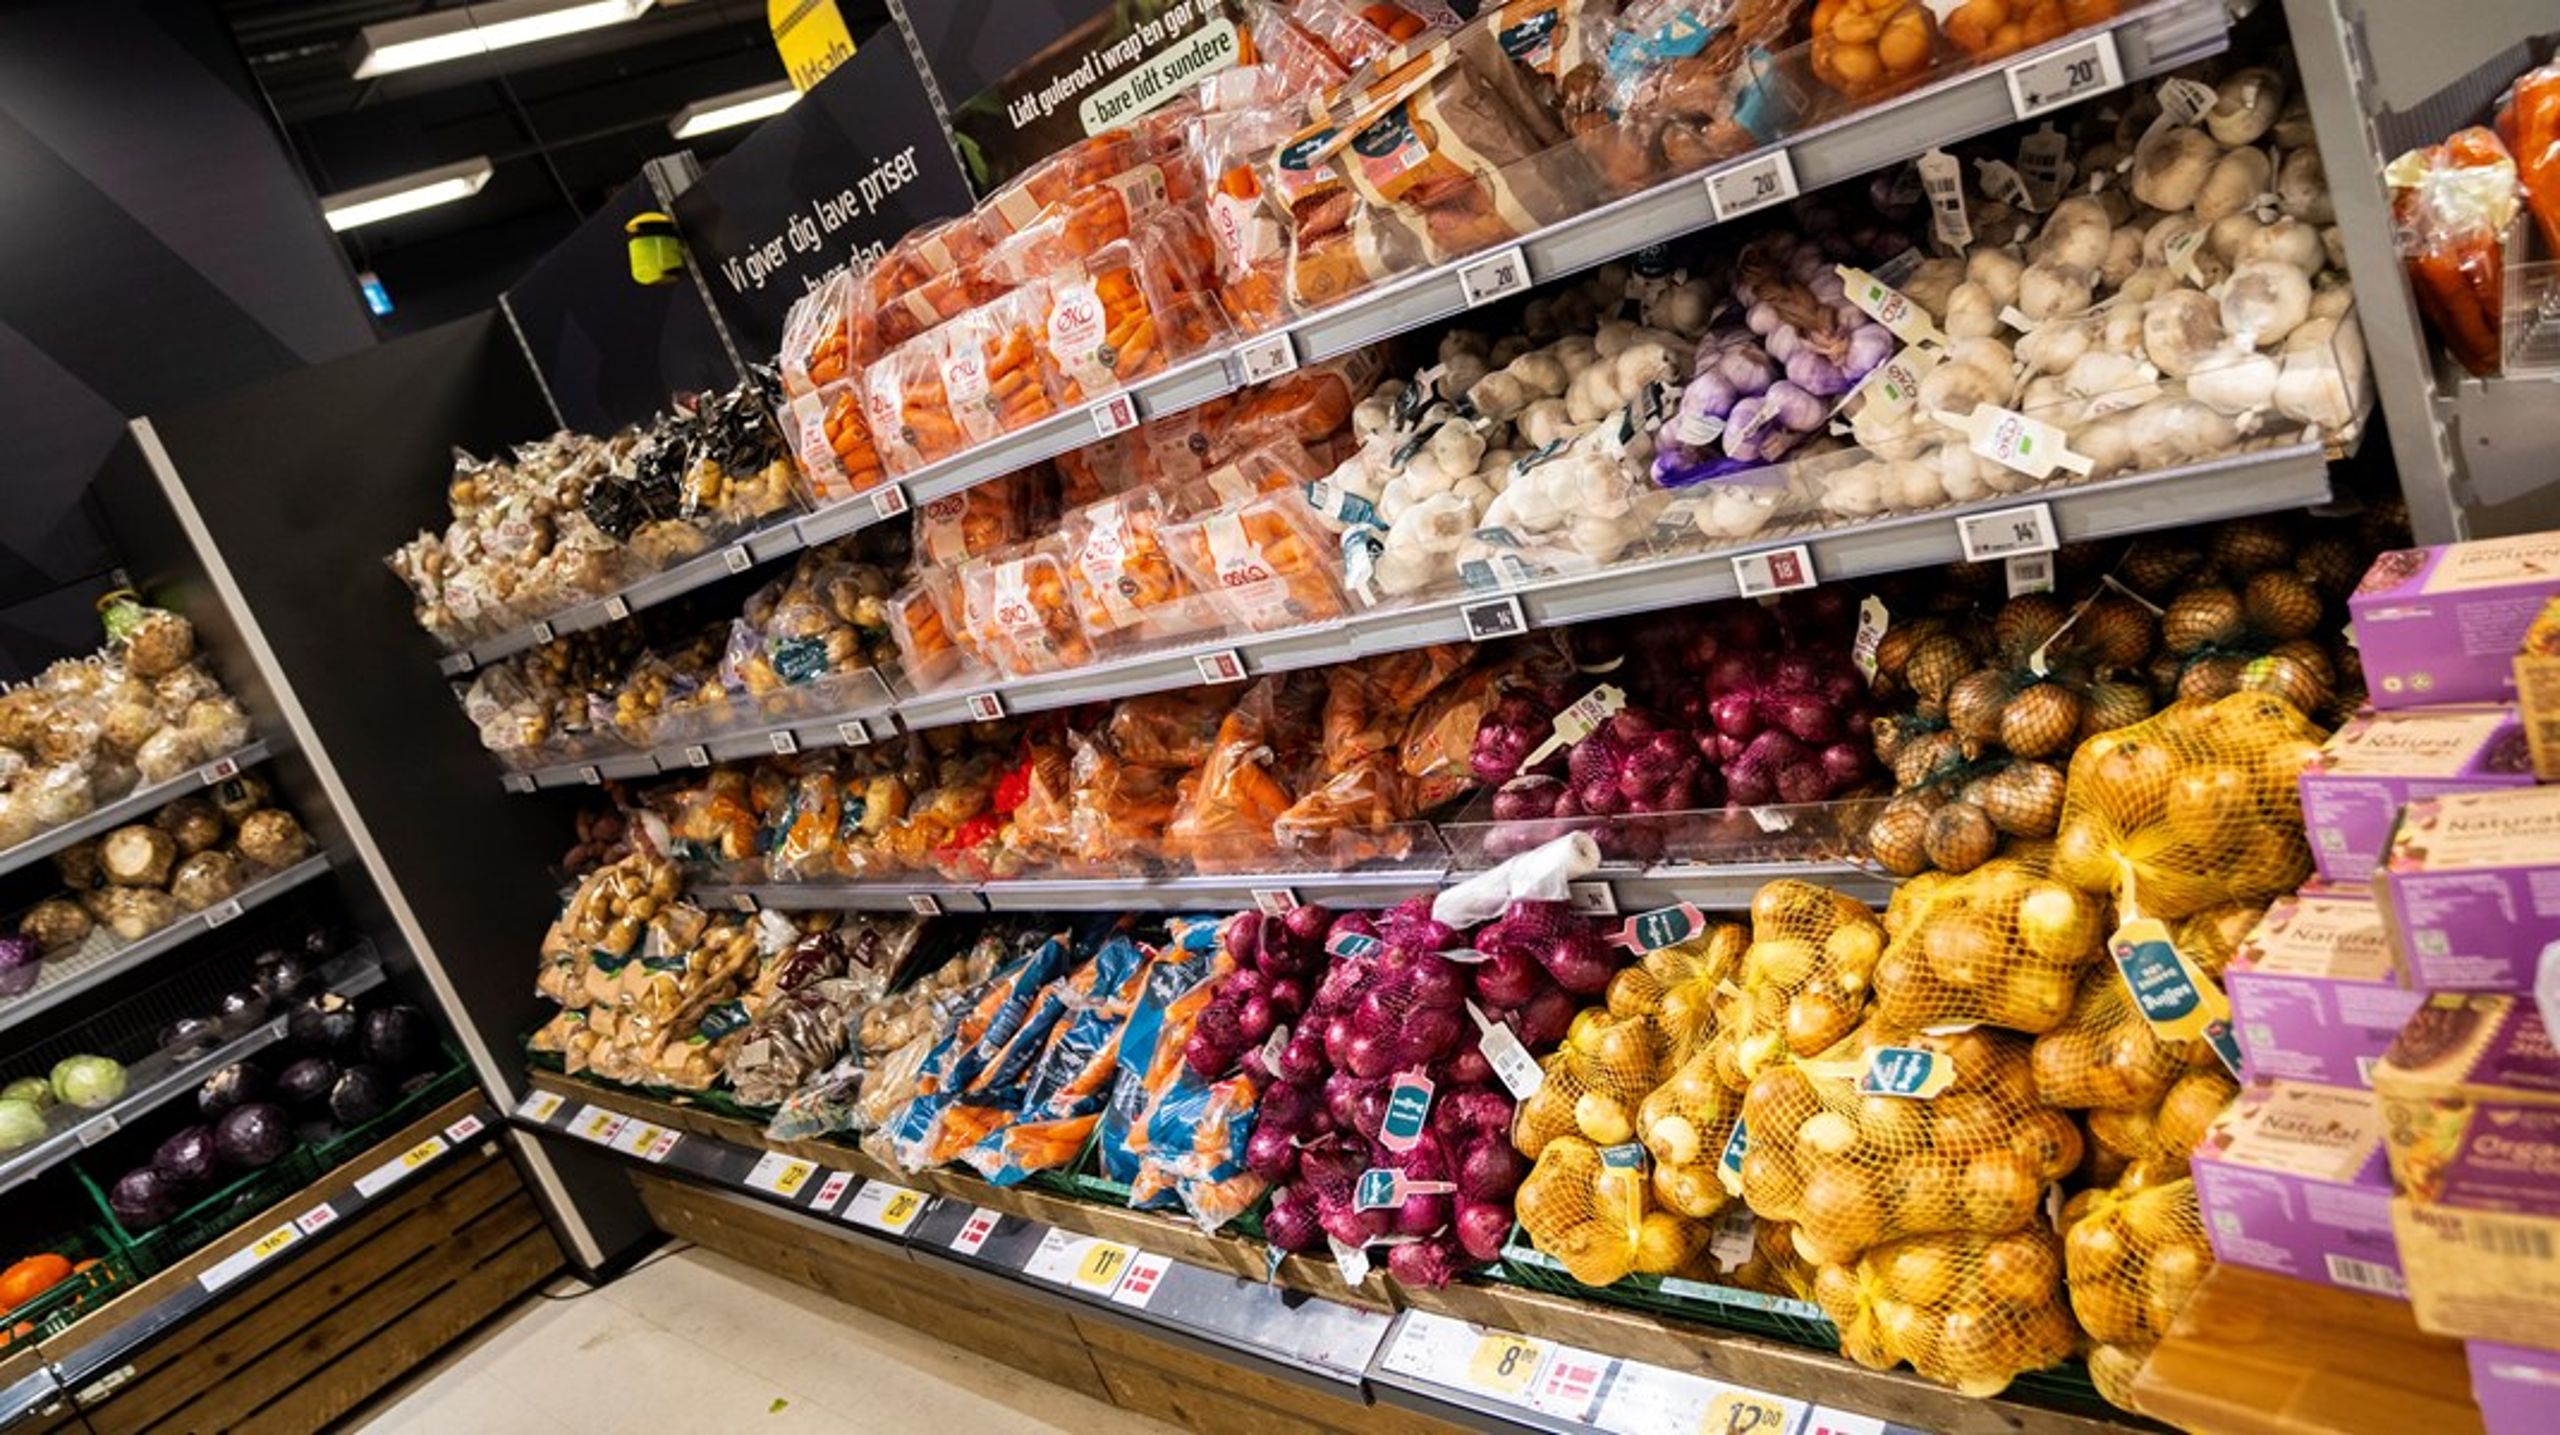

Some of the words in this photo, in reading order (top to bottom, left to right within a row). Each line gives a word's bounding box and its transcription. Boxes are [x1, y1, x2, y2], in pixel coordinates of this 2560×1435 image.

[1007, 91, 1042, 130] Lidt
[1038, 56, 1096, 116] gulerod
[1102, 20, 1165, 71] wrap'en
[1094, 90, 1133, 124] bare
[1131, 67, 1164, 105] lidt
[1161, 31, 1232, 85] sundere
[721, 256, 750, 294] Vi
[745, 233, 788, 289] giver
[788, 213, 823, 252] dig
[812, 190, 861, 233] lave
[856, 145, 920, 215] priser
[1497, 1345, 1522, 1376] 8
